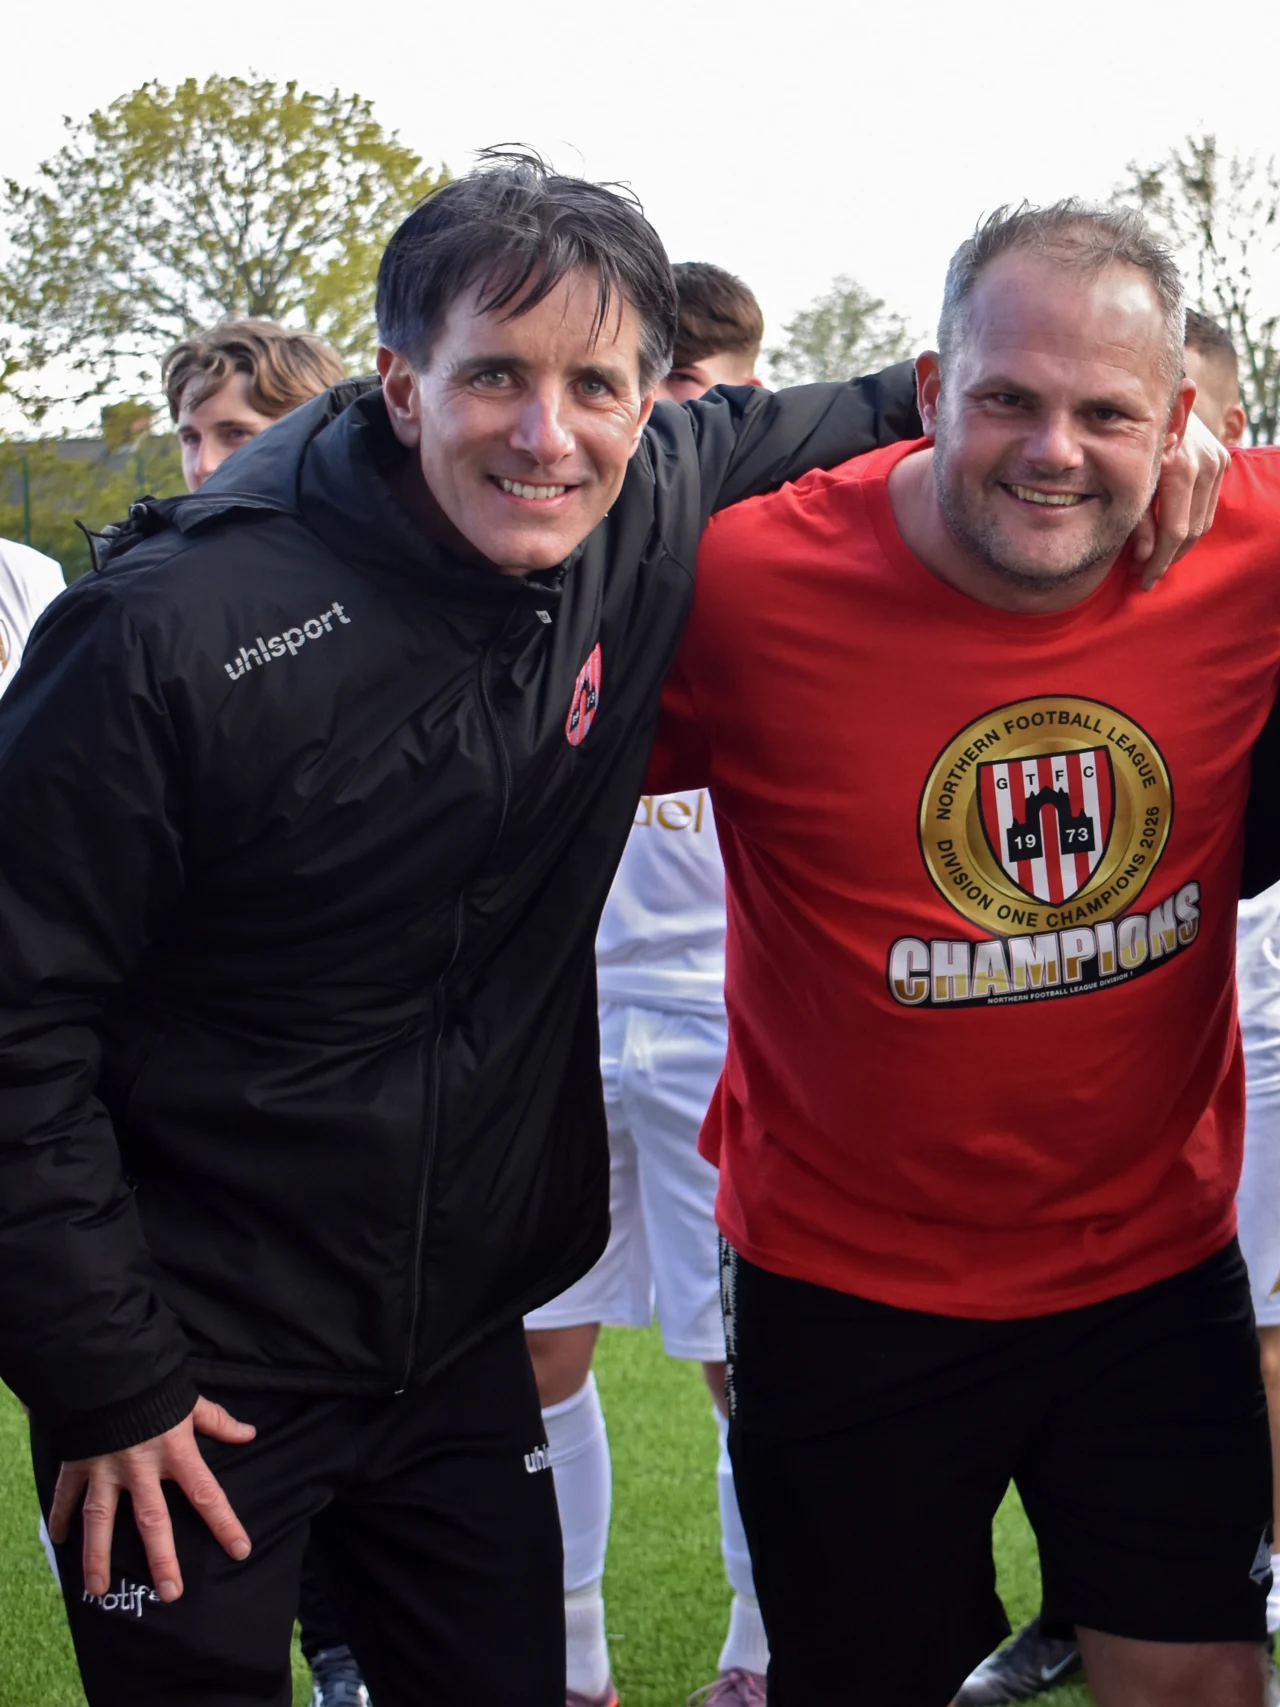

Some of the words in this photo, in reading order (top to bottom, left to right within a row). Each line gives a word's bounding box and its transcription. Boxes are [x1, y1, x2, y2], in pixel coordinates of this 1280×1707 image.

[224, 602, 351, 681] uhlsport
[936, 729, 1001, 820] NORTHERN
[1004, 711, 1102, 735] FOOTBALL
[1106, 726, 1157, 789] LEAGUE
[937, 839, 994, 911] DIVISION
[997, 908, 1038, 928] ONE
[1046, 852, 1146, 928] CHAMPIONS
[1140, 806, 1160, 849] 2026
[1014, 834, 1037, 850] 19
[1065, 828, 1089, 843] 73
[889, 882, 1200, 1004] CHAMPIONS
[987, 994, 1028, 1005] NORTHERN
[1030, 988, 1068, 1000] FOOTBALL
[1070, 982, 1098, 993] LEAGUE
[1099, 973, 1128, 987] DIVISION
